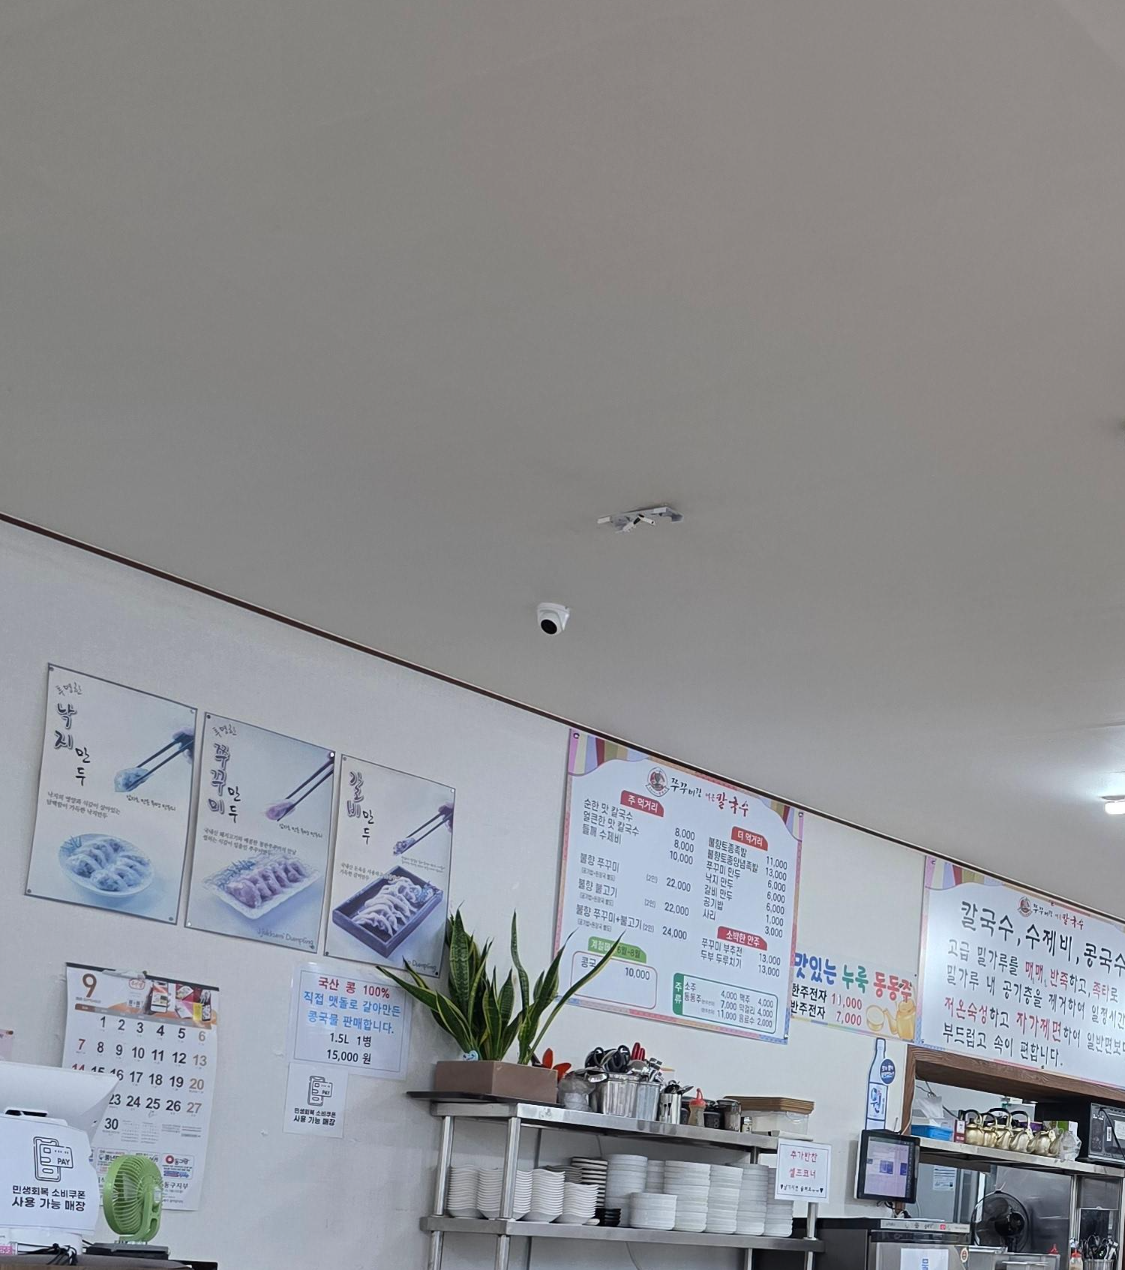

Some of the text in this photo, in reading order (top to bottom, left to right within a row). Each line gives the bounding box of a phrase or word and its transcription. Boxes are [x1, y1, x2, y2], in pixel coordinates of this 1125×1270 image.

[75, 747, 90, 787] 만두
[227, 786, 241, 823] 만두
[584, 799, 633, 822] 순한 맛 칼국수
[628, 794, 658, 813] 주 먹거리
[362, 809, 374, 845] 만두
[583, 811, 640, 836] 얼큰한 맛 칼국수
[600, 830, 621, 844] 수제비
[675, 828, 695, 840] 8,000
[738, 830, 743, 839] 더
[674, 840, 694, 852] 8,000
[670, 850, 693, 865] 10,000
[766, 856, 787, 870] 11,000
[706, 860, 740, 879] 쭈꾸미 만두
[766, 867, 786, 881] 13,000
[666, 877, 691, 892] 22,000
[706, 873, 733, 888] 낙지 만두
[768, 880, 786, 892] 6,000
[596, 883, 617, 898] 불고기
[664, 902, 689, 916] 22,000
[705, 885, 733, 900] 갈비 만두
[767, 891, 785, 903] 6,000
[704, 896, 723, 910] 공기밥
[766, 903, 784, 915] 6,000
[703, 909, 715, 920] 사리
[766, 914, 783, 926] 1,000
[662, 926, 687, 940] 24,000
[765, 926, 782, 938] 3,000
[961, 901, 1021, 946] 칼국수,
[1025, 924, 1080, 964] 수제비,
[747, 936, 760, 946] 안주
[723, 944, 742, 957] 부추전
[701, 950, 741, 968] 두부 두루치기
[760, 953, 780, 965] 13,000
[625, 967, 650, 980] 10,000
[759, 965, 779, 977] 13,000
[794, 952, 912, 1003] 맛있는 누룩 동동주
[948, 938, 1119, 1003] 고급 밀가루를 반죽하고, 족타로
[82, 973, 97, 998] 9
[318, 976, 390, 999] 국산 콩 100%
[685, 982, 773, 1008] 소주 4,000 맥주 4,000
[792, 983, 862, 1010] 한주전자 11,000
[947, 965, 1125, 1030] 밀가루 내 공기층을 제거하여 일정시간
[303, 991, 401, 1018] 직접 맷돌로 갈아만든
[685, 992, 701, 1003] 동동주
[721, 1000, 737, 1010] 7,000
[739, 1004, 755, 1015] 막걸리
[757, 1008, 773, 1018] 4,000
[717, 1010, 772, 1028] 11,000 음료수 2,000
[791, 1000, 862, 1026] 반주전자 7,000
[100, 1016, 206, 1042] 1 2 3 4 5 6
[307, 1010, 394, 1034] 콩국물 판매합니다.
[944, 996, 1010, 1029] 저온숙성하고
[1016, 1011, 1081, 1048] 자가제면하여
[330, 1032, 372, 1047] 1.5L 1병
[943, 1022, 1063, 1067] 부드럽고 속이 편합니다.
[78, 1038, 207, 1067] 7 8 9 10 11 12 13
[326, 1049, 371, 1065] 15,000 원
[129, 1071, 205, 1091] 17 18 19 20
[126, 1095, 202, 1113] 24 25 26 27
[293, 1114, 336, 1126] 사용 가능 매장
[294, 1107, 337, 1118] 민생회복 소비쿠폰
[104, 1118, 119, 1130] 30
[57, 1158, 70, 1166] PAY
[790, 1150, 818, 1163] 추가반찬
[789, 1167, 816, 1180] 셀프코너
[12, 1185, 86, 1199] 민생회복 소비쿠폰
[11, 1197, 86, 1212] 사용 가능 매장
